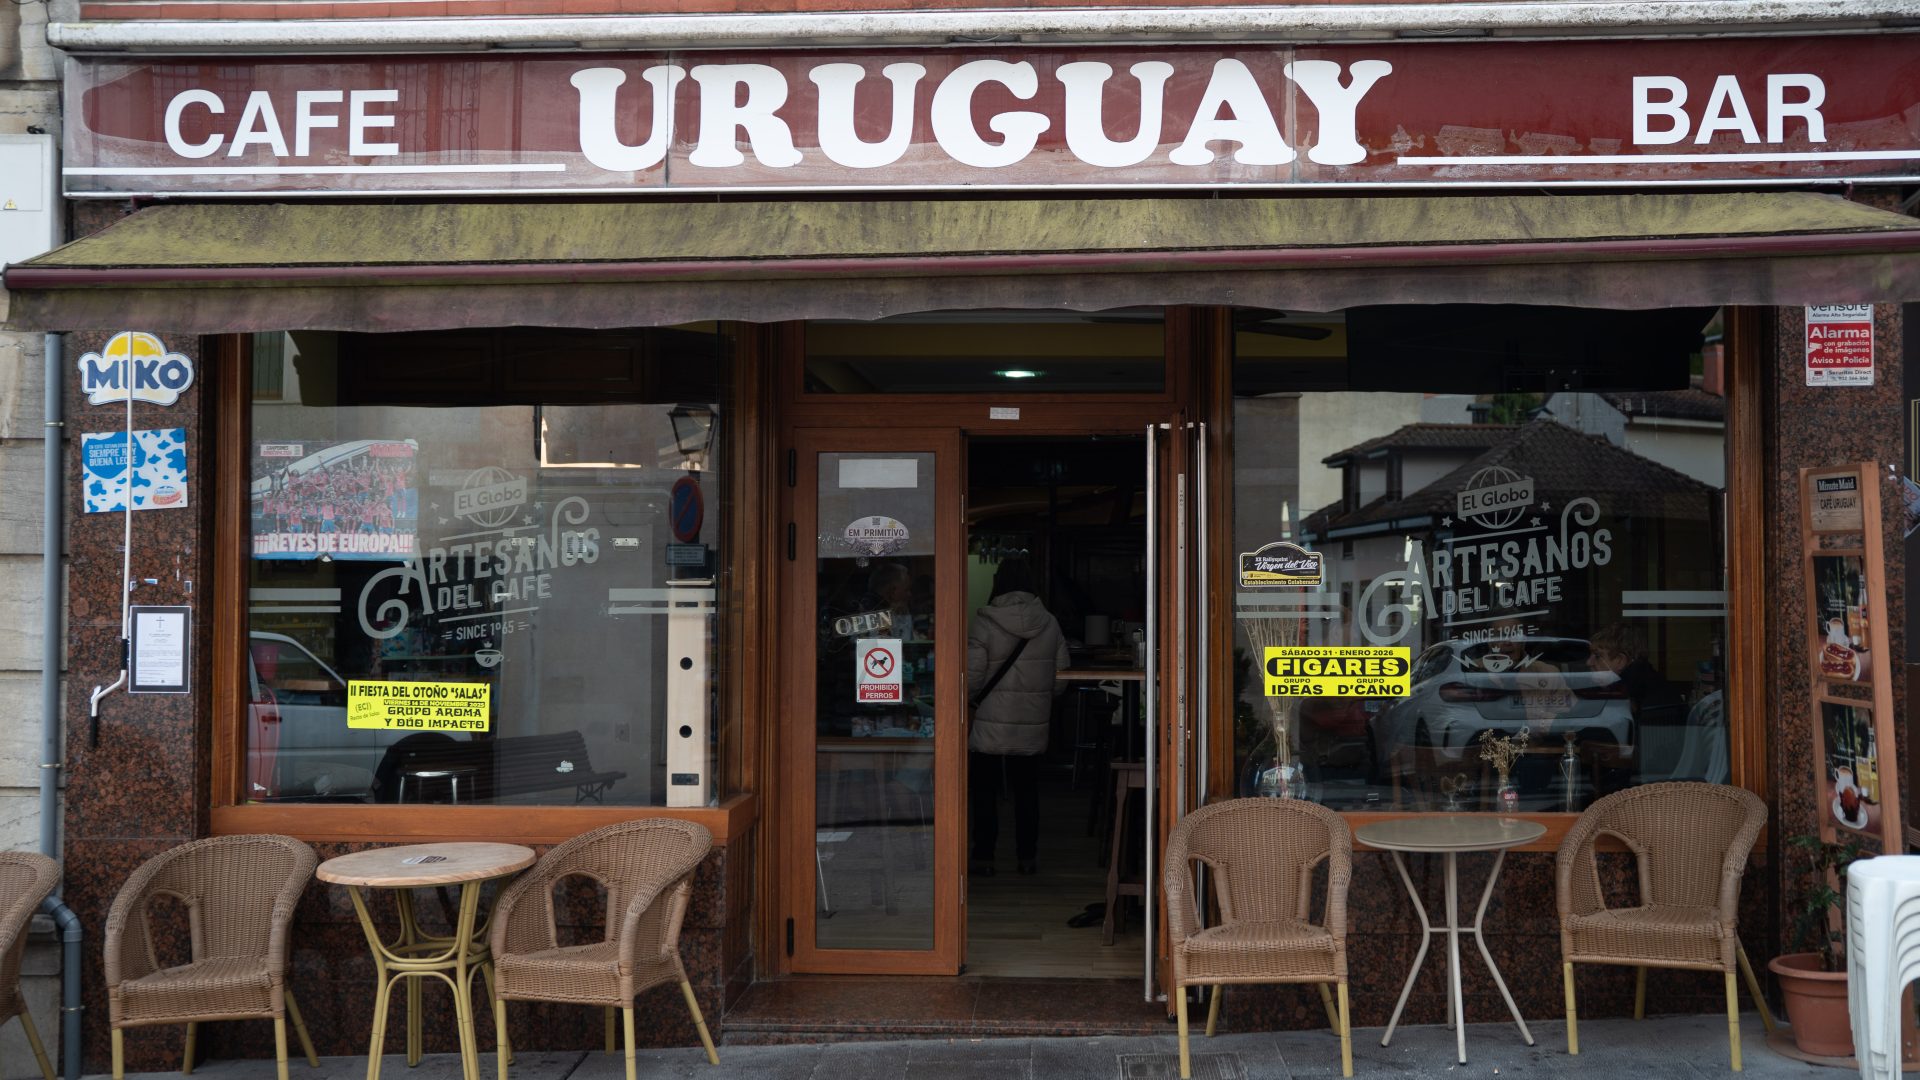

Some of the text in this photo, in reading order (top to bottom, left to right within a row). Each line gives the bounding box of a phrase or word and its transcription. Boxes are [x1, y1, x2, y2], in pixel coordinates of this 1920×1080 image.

[164, 58, 1827, 171] CAFE URUGUAY BAR
[1809, 326, 1870, 339] Alarma
[1836, 339, 1870, 348] grabación
[1843, 356, 1870, 364] Policía
[87, 359, 189, 390] MIKO
[89, 447, 136, 458] SIEMPRE HY
[89, 456, 137, 466] BUENA LECE
[457, 488, 522, 510] El Globo
[1462, 488, 1529, 511] El Globo
[1833, 496, 1856, 509] URUGUAY
[848, 528, 904, 537] EM PRIMITIVO
[318, 533, 337, 553] DE
[340, 533, 414, 553] EUROPA!!!
[358, 496, 600, 639] ARTESANOS
[1254, 559, 1318, 572] Virgen del Viso
[1358, 497, 1612, 645] ARTESANOS
[437, 573, 553, 612] DEL CAFE
[1442, 575, 1563, 616] DEL CAFE
[835, 610, 892, 635] OPEN
[456, 624, 487, 641] SINCE
[1462, 625, 1524, 644] SINCE 1965
[1281, 648, 1320, 656] SÁBADO
[1276, 658, 1400, 675] FIGARES
[359, 685, 389, 697] FIESTA
[392, 686, 411, 698] DEL
[412, 684, 448, 699] OTOÑO
[1271, 685, 1323, 695] IDEAS
[1337, 685, 1404, 695] D'CANO
[388, 706, 482, 717] GRUPO AROMA
[385, 717, 485, 729] Y DÚO IMPACTO
